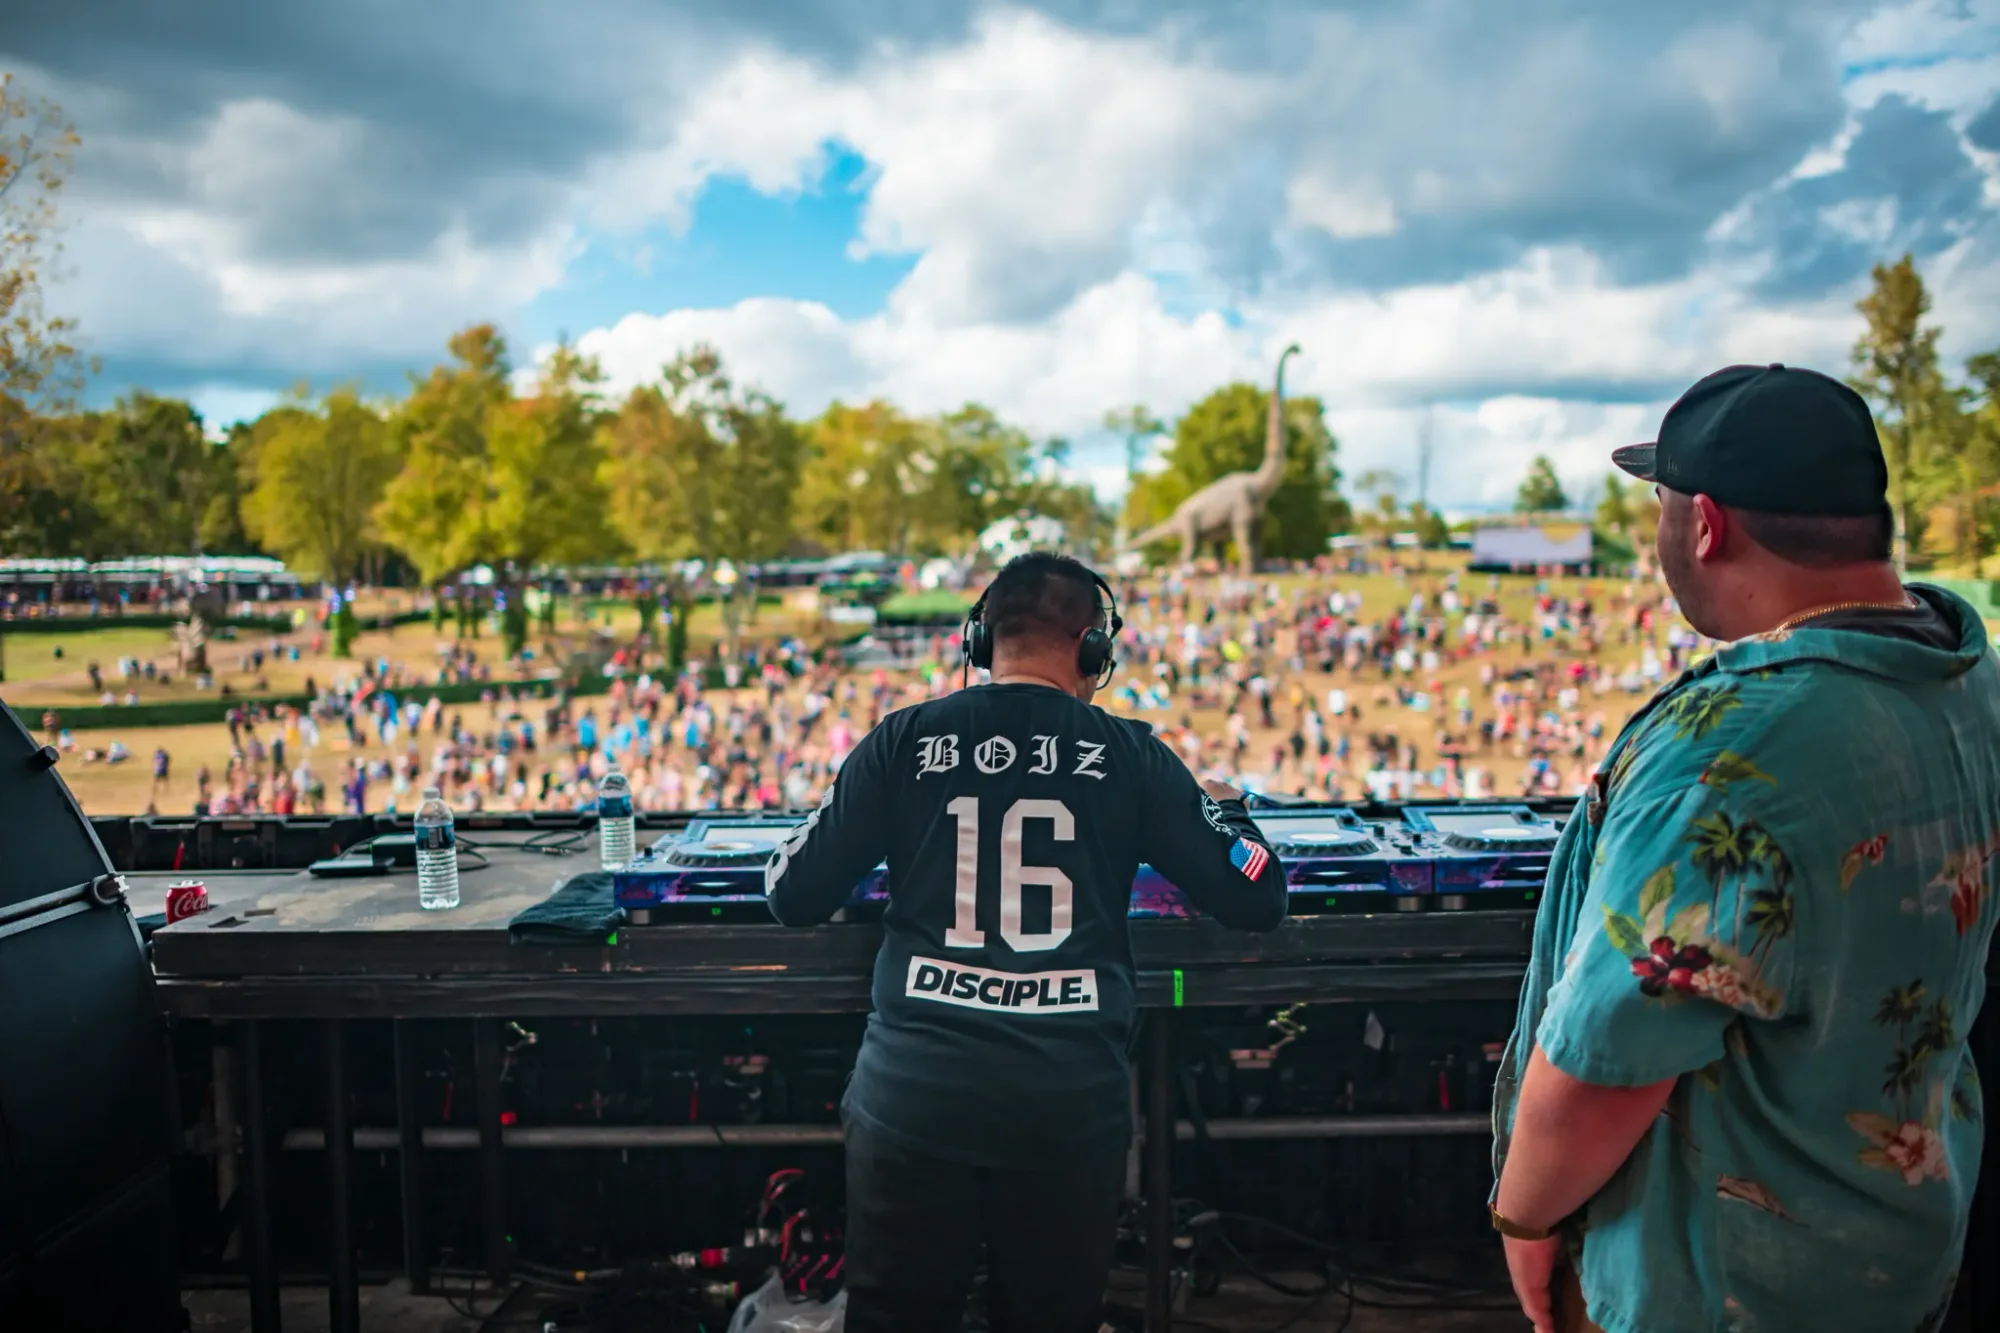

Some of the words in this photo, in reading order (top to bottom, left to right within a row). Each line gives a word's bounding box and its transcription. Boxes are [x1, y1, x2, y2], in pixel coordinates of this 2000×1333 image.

[916, 734, 1107, 780] BOIZ
[945, 796, 1075, 952] 16
[913, 964, 1092, 1007] DISCIPLE.
